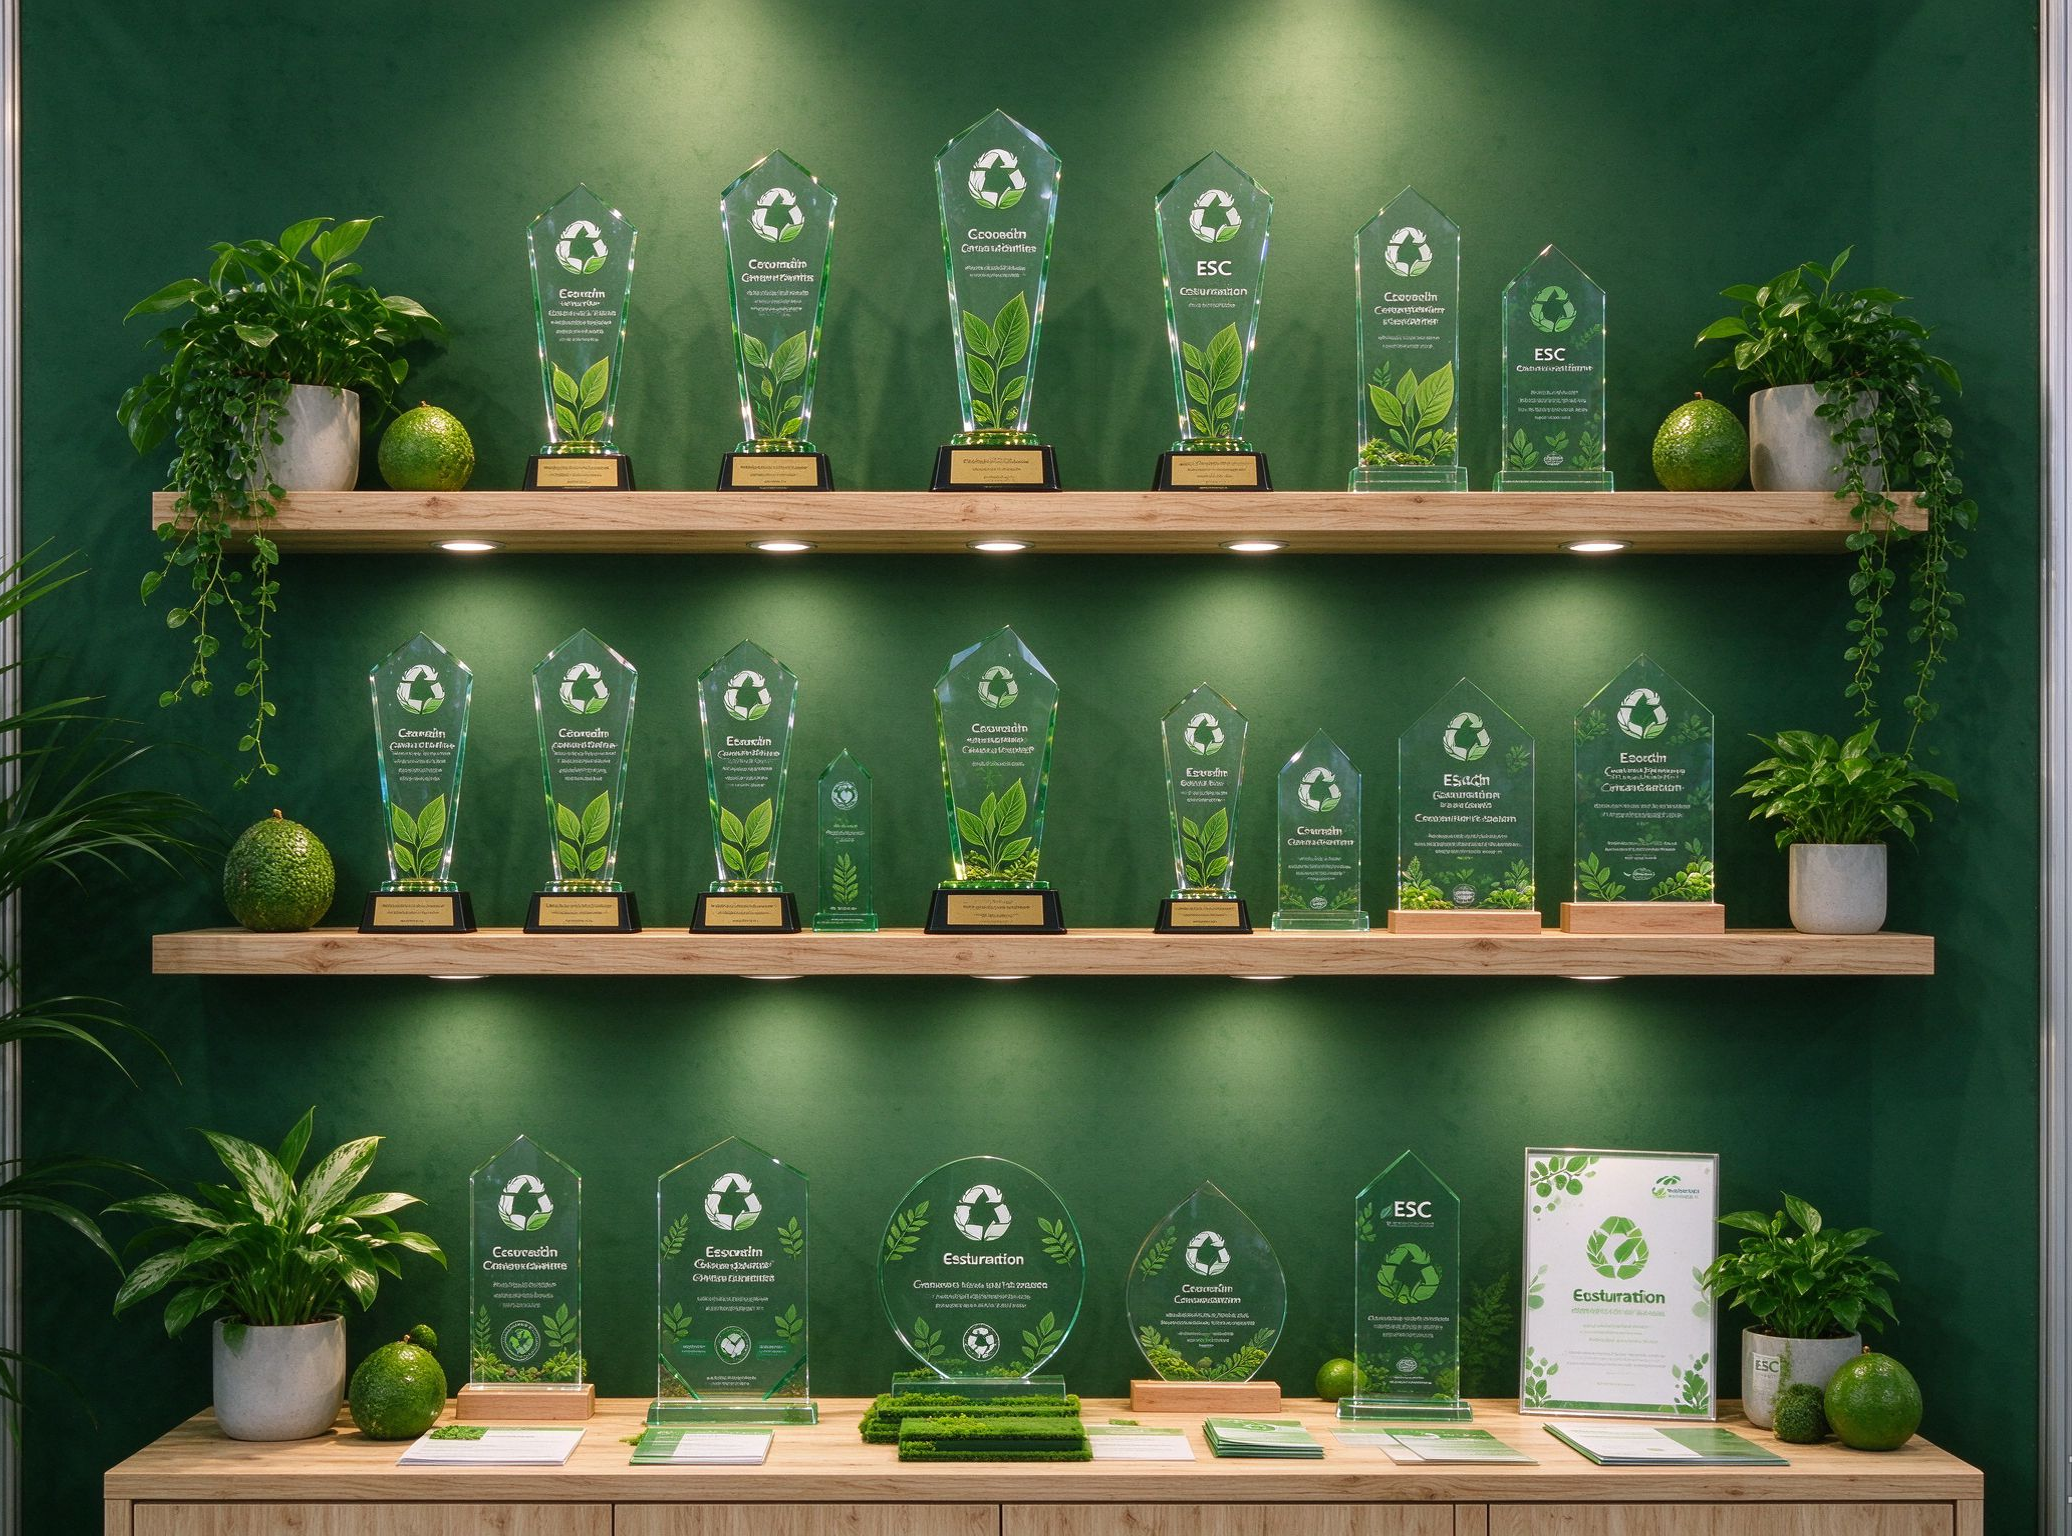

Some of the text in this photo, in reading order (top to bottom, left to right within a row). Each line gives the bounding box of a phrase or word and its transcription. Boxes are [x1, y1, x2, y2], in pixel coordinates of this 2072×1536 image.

[1196, 260, 1233, 276] ESC
[1534, 347, 1566, 361] ESC
[1393, 1200, 1433, 1219] ESC
[1754, 1359, 1781, 1373] ESC
